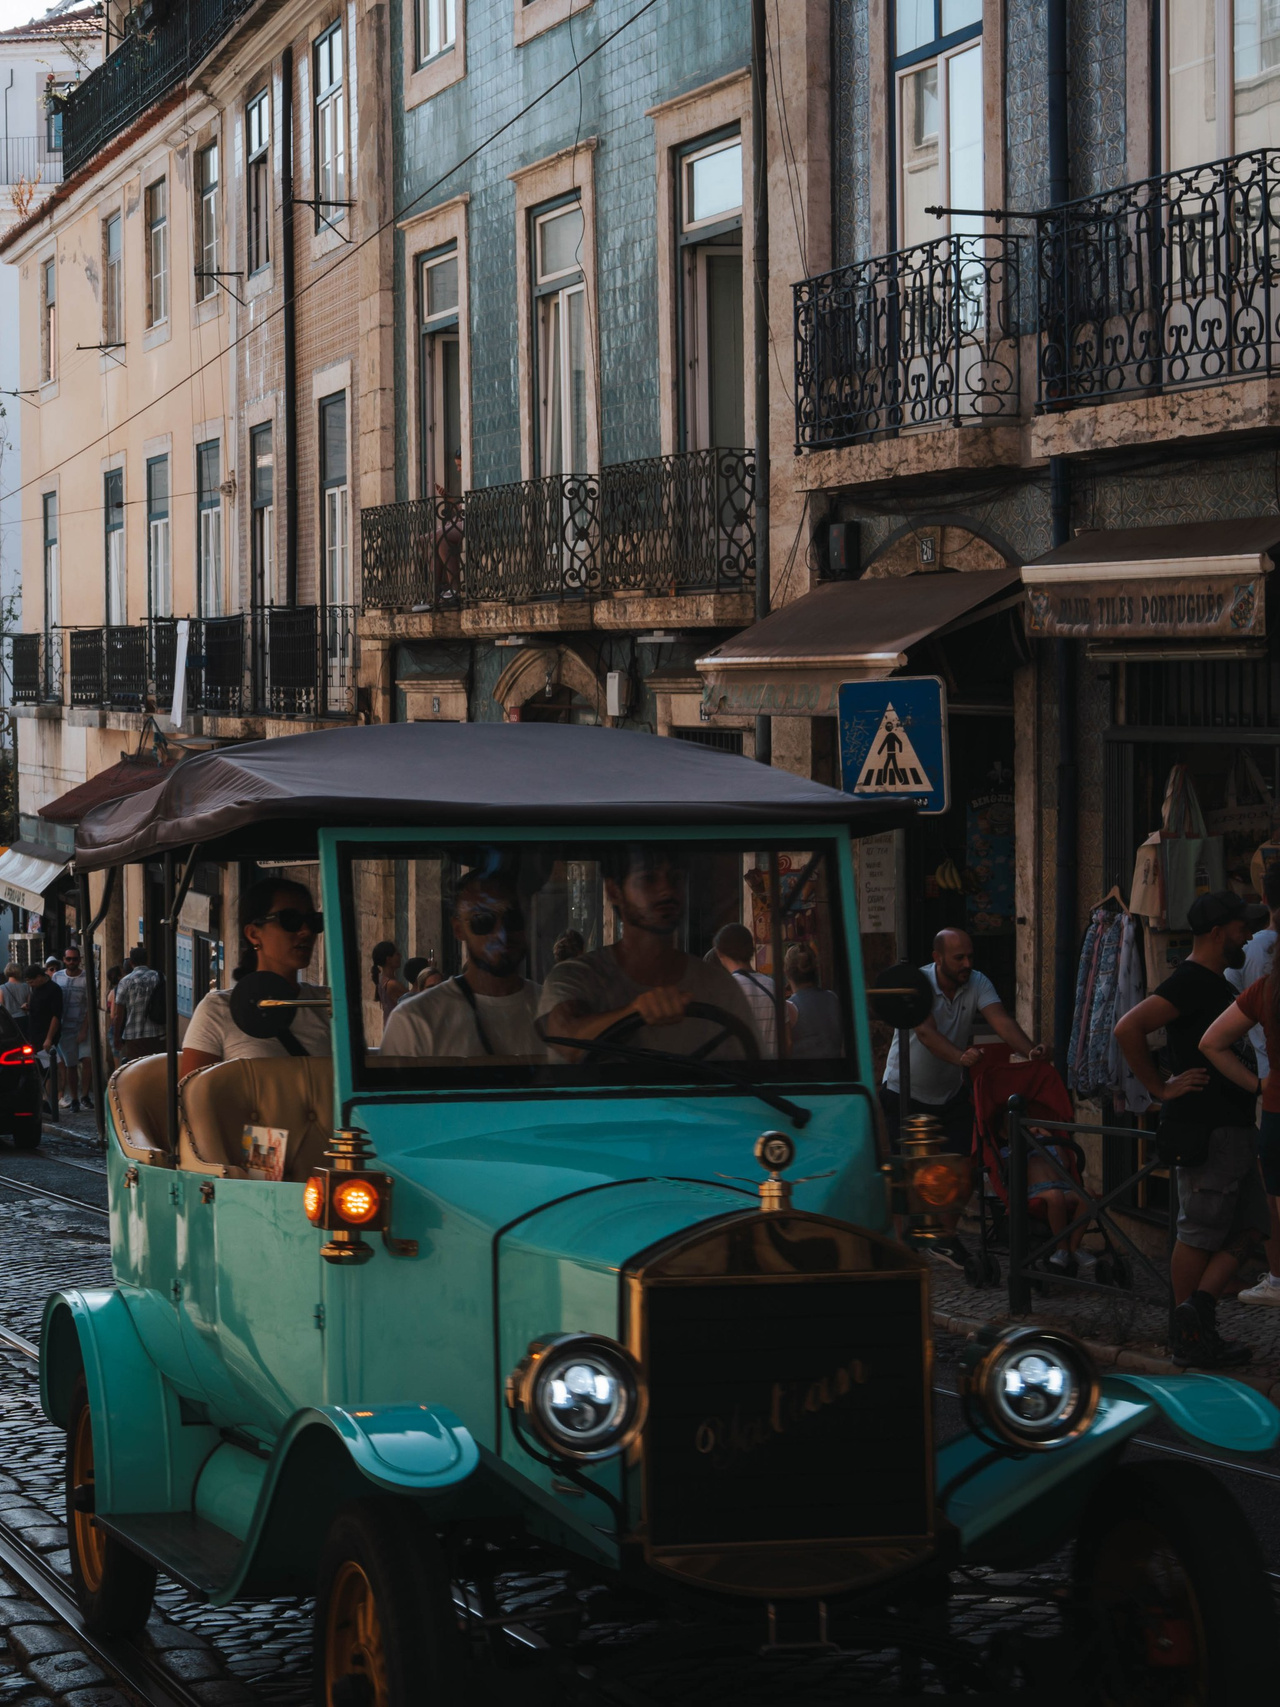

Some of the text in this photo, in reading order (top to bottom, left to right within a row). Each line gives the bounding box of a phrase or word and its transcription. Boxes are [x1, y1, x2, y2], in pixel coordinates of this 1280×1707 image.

[922, 540, 932, 560] 20
[1056, 585, 1224, 625] BLUE TILES PORTUGUÊS
